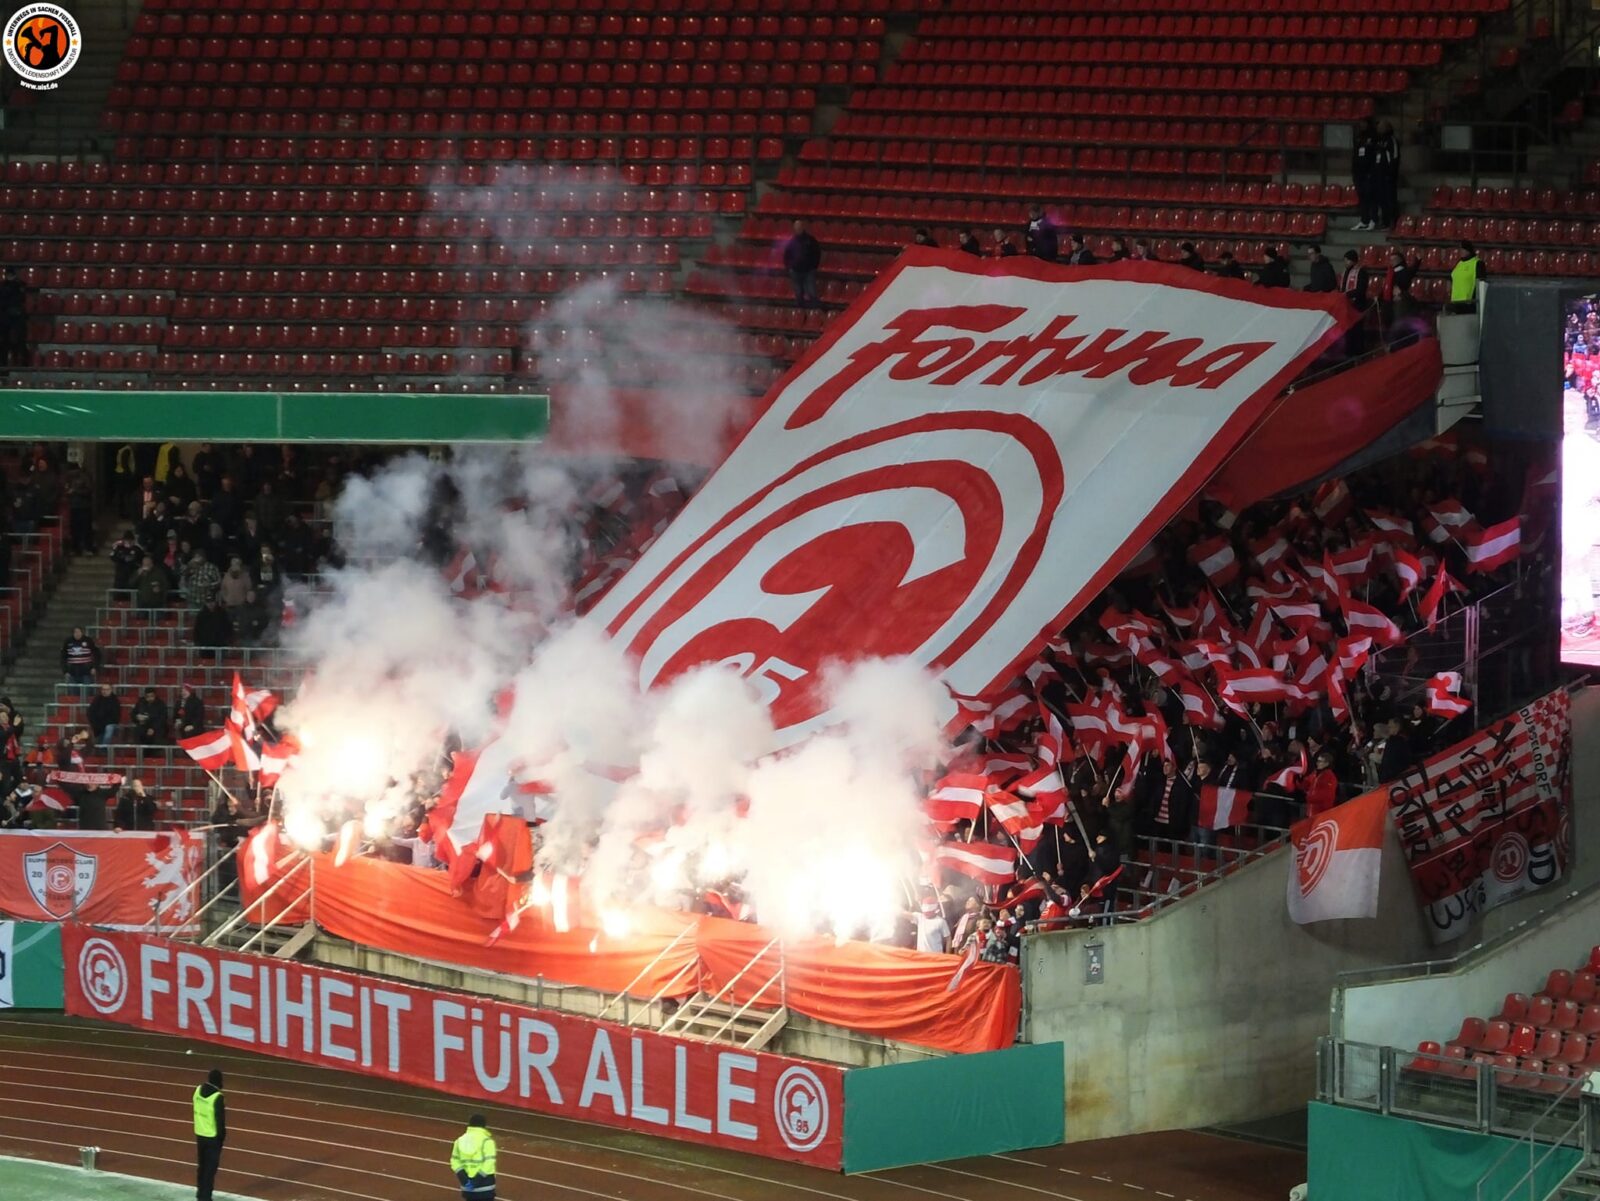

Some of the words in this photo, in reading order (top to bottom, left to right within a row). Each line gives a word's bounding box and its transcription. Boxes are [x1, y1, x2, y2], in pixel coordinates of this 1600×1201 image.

[783, 304, 1277, 430] Fortuna
[140, 944, 411, 1072] FREIHEIT
[432, 999, 564, 1105] FÜR
[579, 1028, 758, 1141] ALLE
